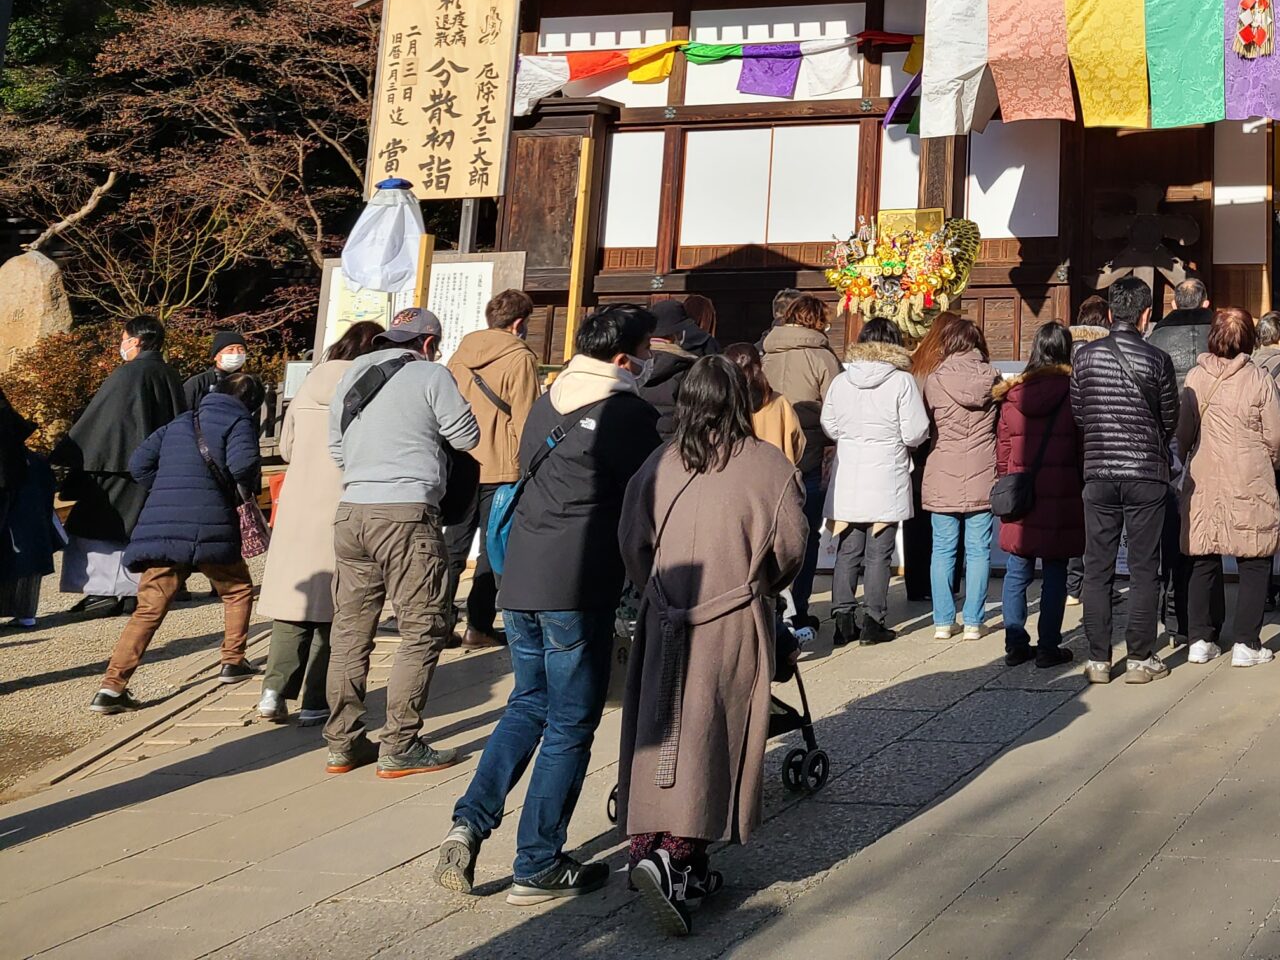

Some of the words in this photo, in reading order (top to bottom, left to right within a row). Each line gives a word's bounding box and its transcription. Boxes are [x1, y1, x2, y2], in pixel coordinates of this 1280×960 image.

[434, 14, 451, 48] 退散
[449, 10, 469, 48] 疫病
[386, 32, 403, 104] 旧暦一月三日
[402, 25, 422, 102] 二月三日
[389, 105, 409, 126] 迄
[417, 56, 469, 194] 分散初詣
[468, 62, 500, 193] 厄除元三大師
[560, 869, 579, 886] N
